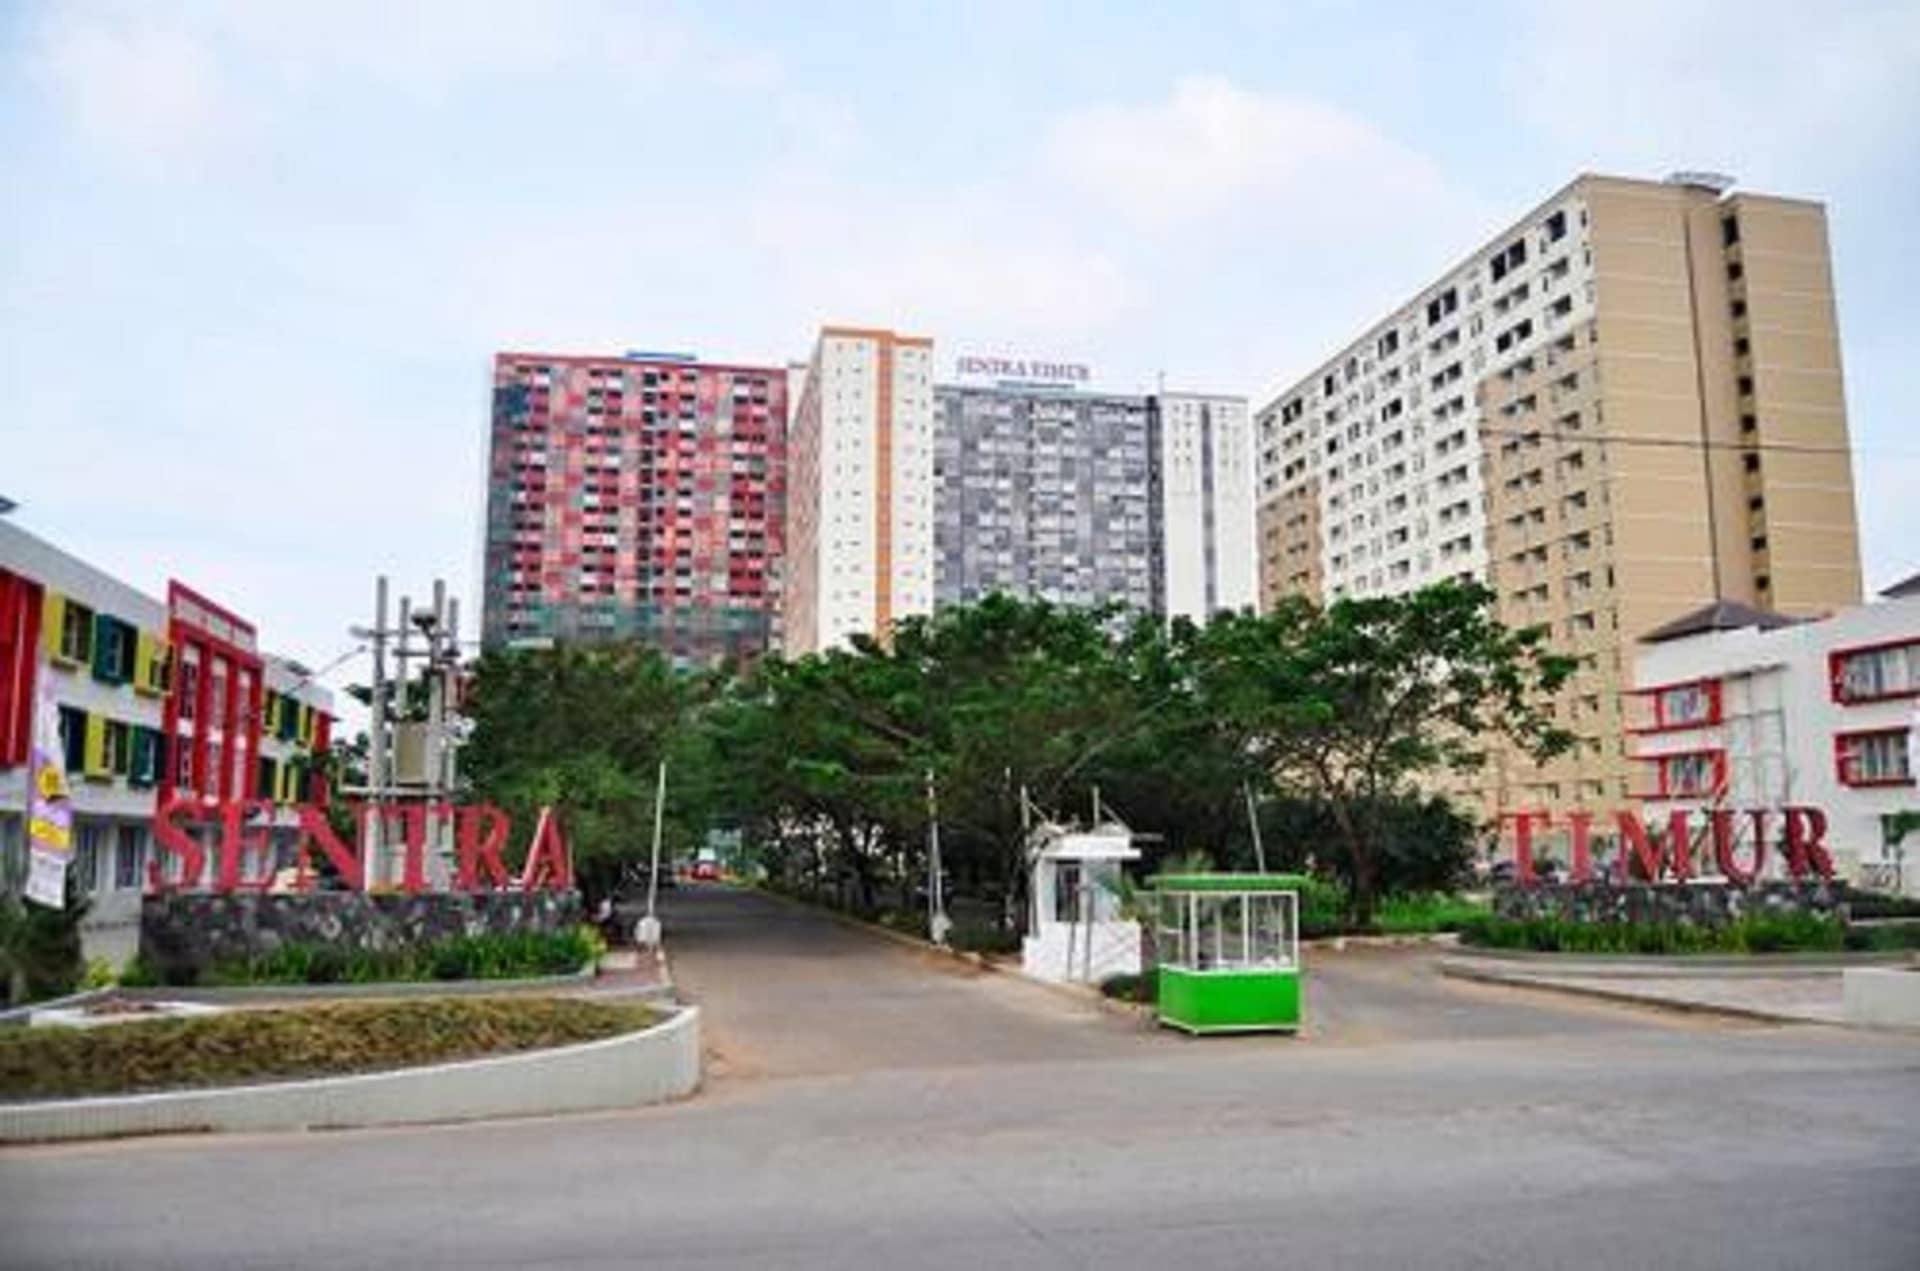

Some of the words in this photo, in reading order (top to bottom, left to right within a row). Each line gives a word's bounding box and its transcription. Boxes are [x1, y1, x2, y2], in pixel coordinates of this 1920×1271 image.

[957, 356, 1026, 377] SENTRA
[149, 798, 576, 892] SENTRA
[1500, 806, 1836, 887] TIMUR
